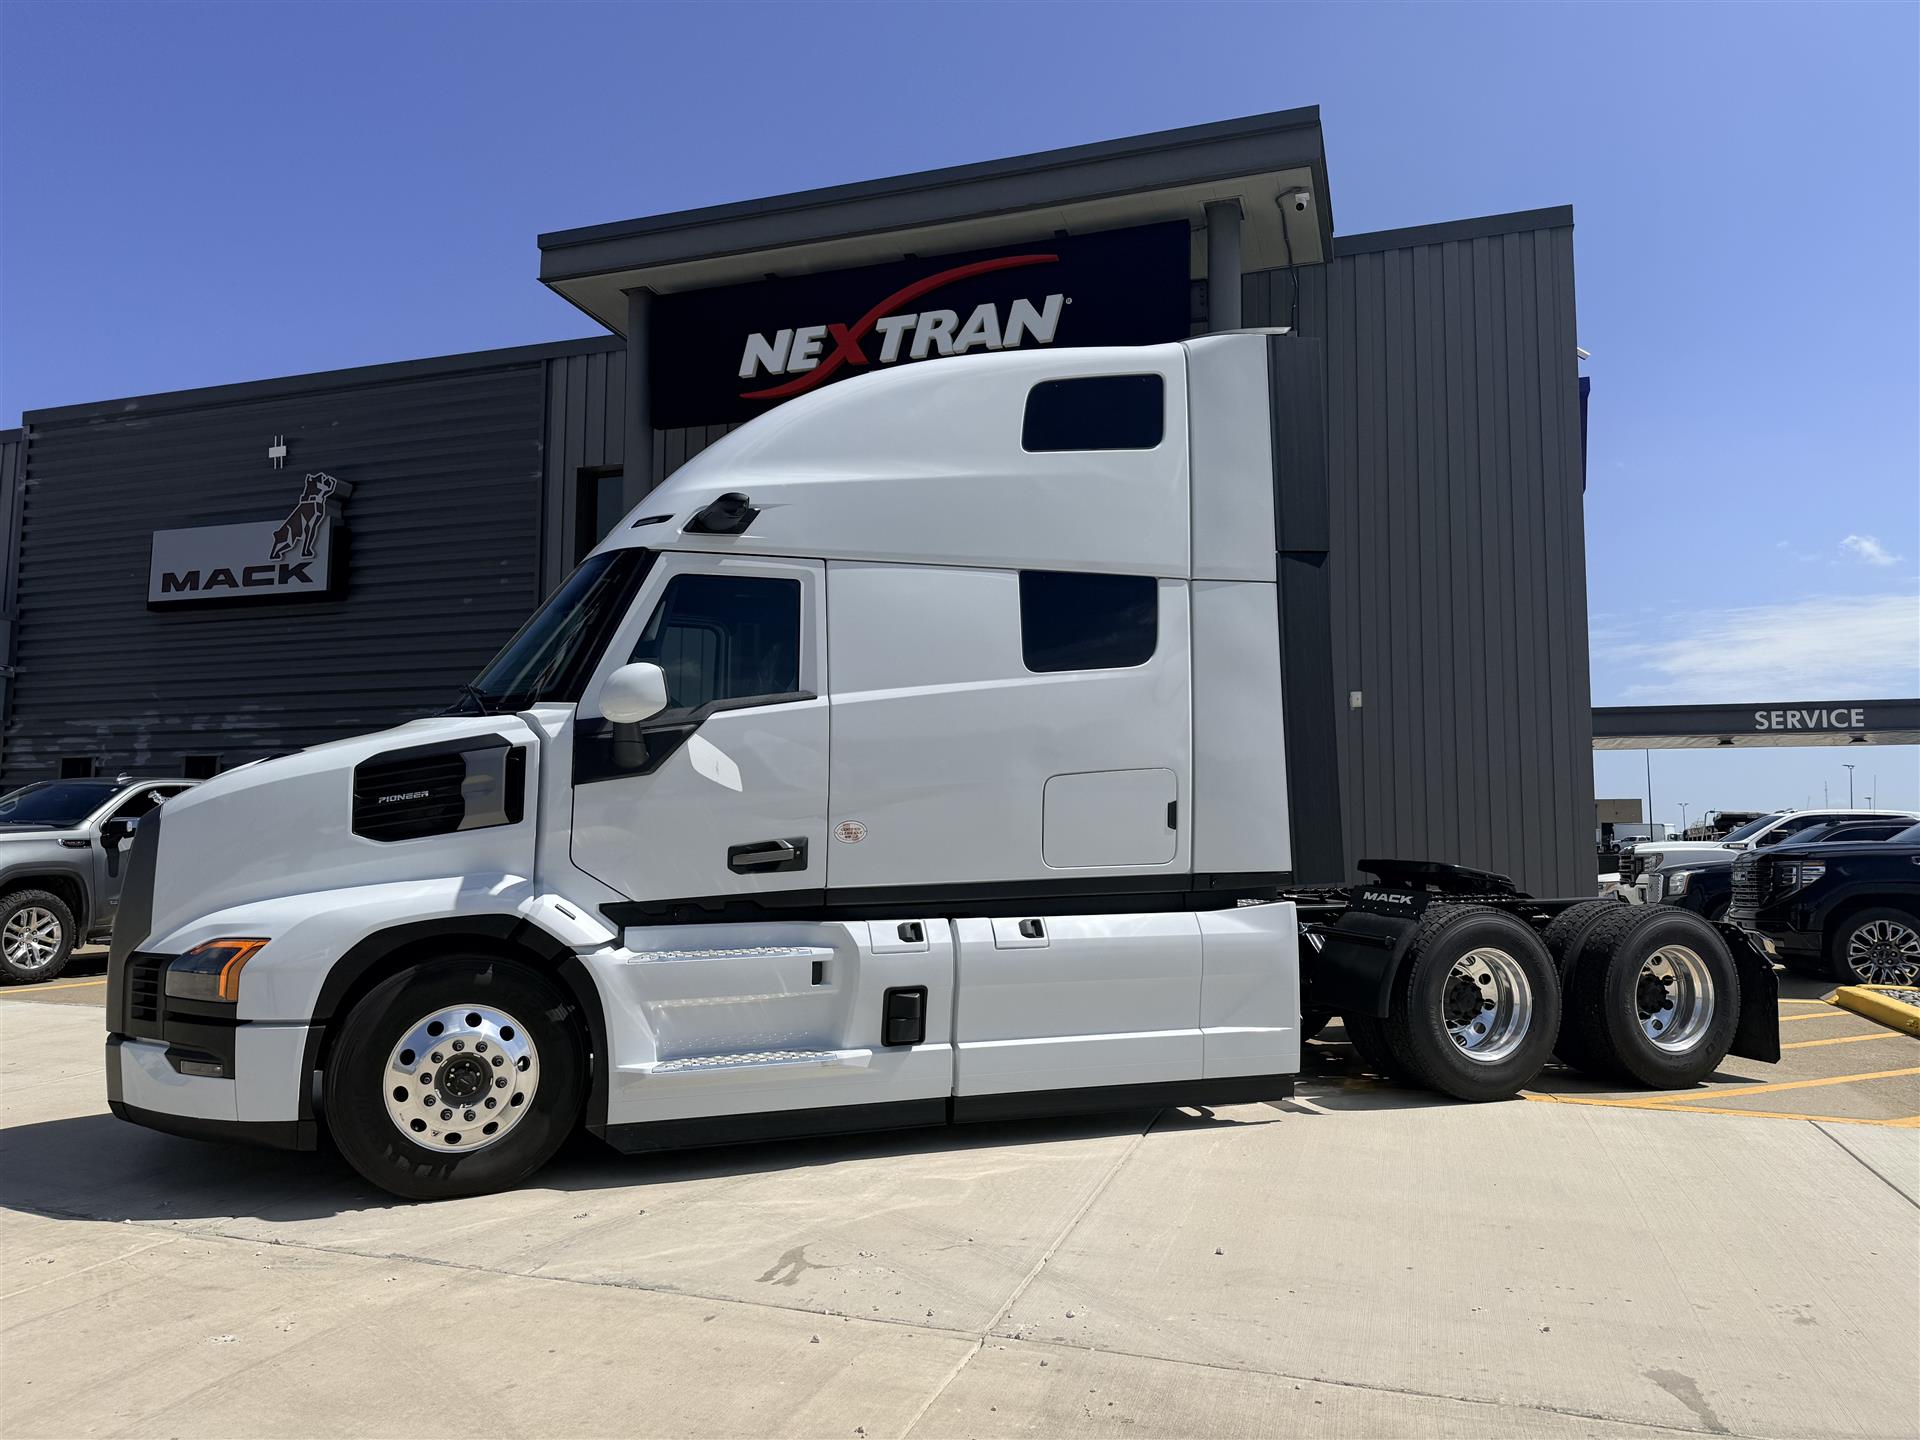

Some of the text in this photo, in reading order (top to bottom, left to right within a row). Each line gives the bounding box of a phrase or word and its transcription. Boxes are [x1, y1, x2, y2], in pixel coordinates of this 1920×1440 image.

[738, 293, 1065, 380] NEXTRAN
[161, 562, 314, 593] MACK
[1754, 708, 1865, 730] SERVICE
[378, 790, 430, 804] PIONEER
[1363, 891, 1414, 905] MACK
